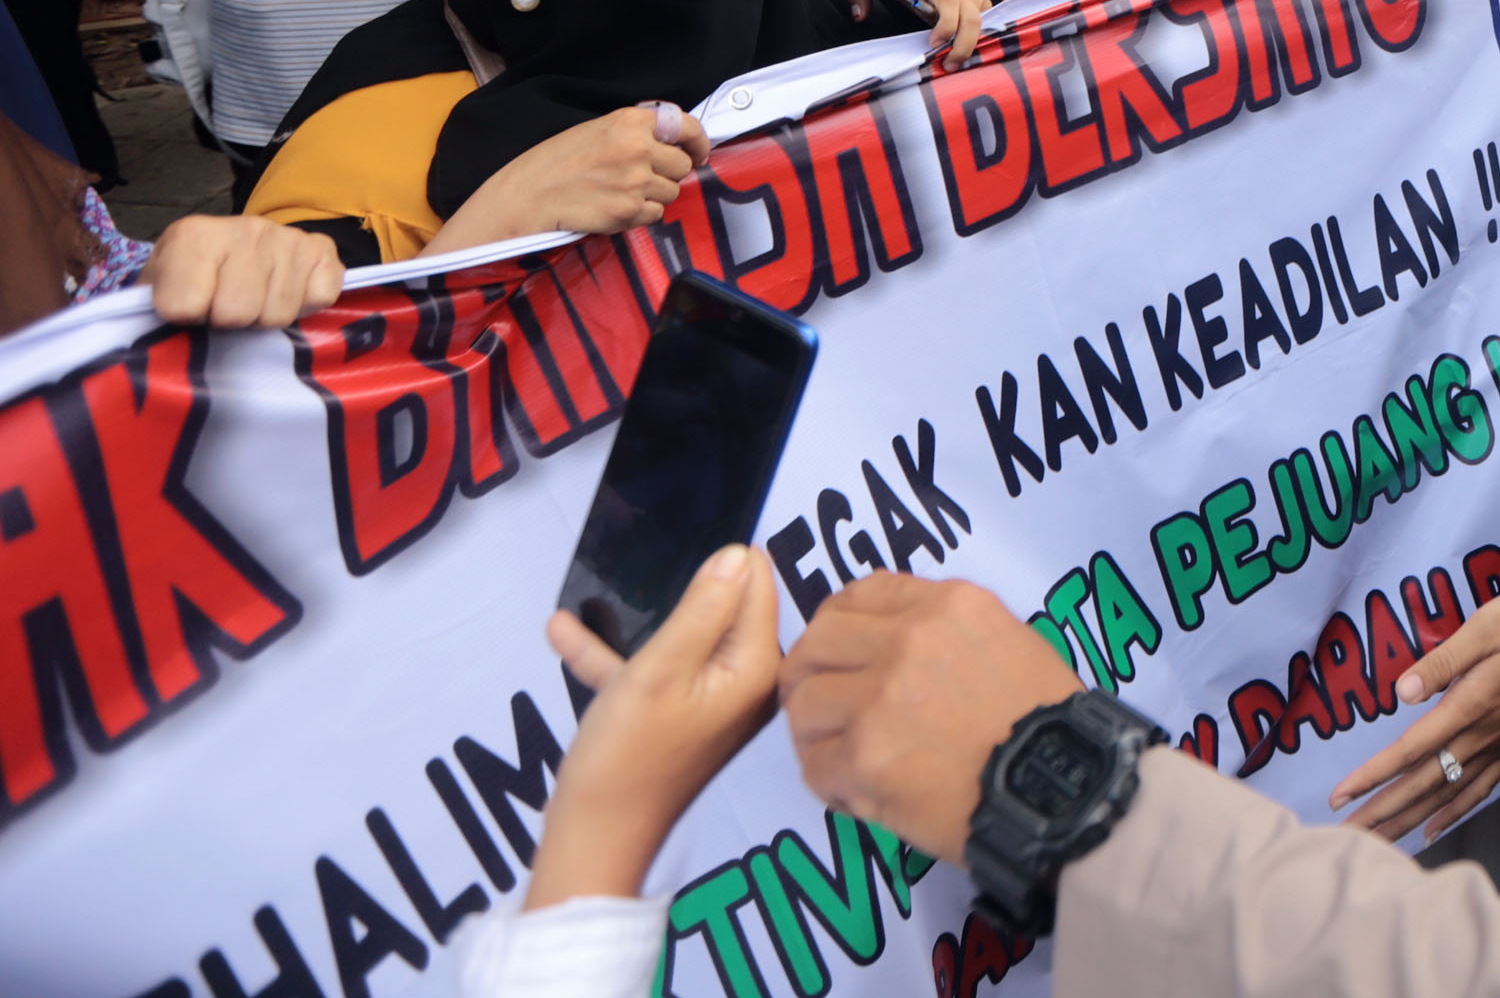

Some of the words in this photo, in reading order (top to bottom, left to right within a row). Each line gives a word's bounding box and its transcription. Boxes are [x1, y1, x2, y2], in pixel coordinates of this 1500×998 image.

[767, 418, 972, 627] EGAK
[975, 321, 1148, 497] KAN
[1143, 167, 1460, 412] KEADILAN
[1151, 353, 1495, 632] PEJUANG
[1227, 566, 1466, 779] DARAH
